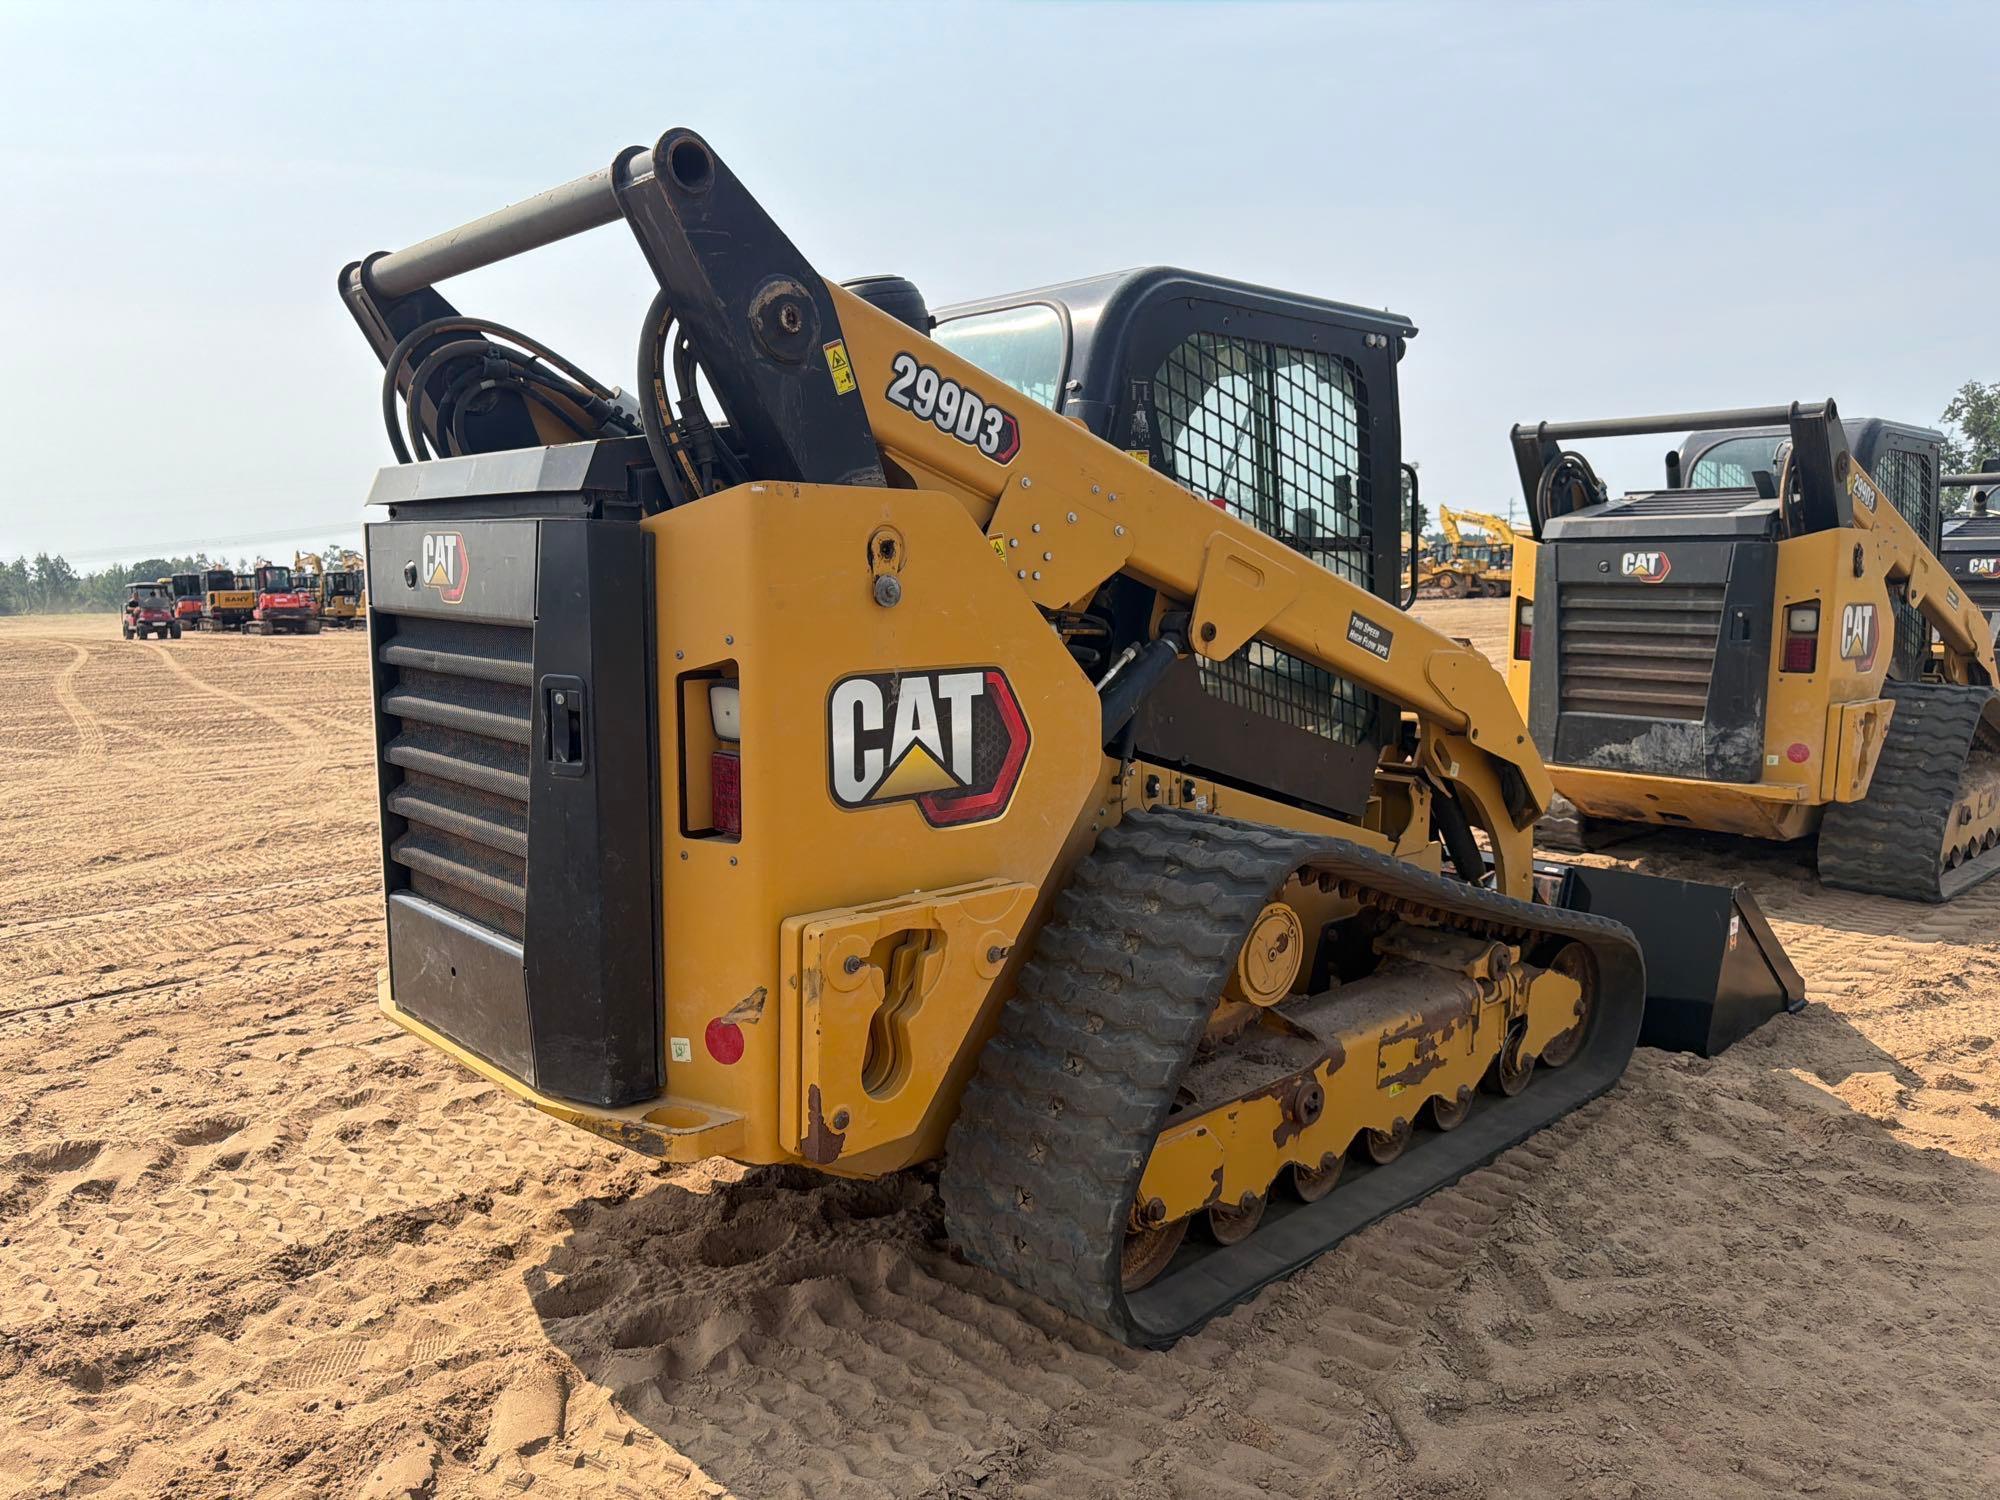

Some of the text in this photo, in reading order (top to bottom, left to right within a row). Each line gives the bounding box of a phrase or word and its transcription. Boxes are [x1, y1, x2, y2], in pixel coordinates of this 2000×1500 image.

[887, 354, 1004, 454] 299D3
[422, 534, 457, 584] CAT
[1622, 552, 1659, 575] CAT
[1968, 558, 1997, 573] CAT
[1841, 605, 1873, 658] CAT
[831, 671, 984, 802] CAT
